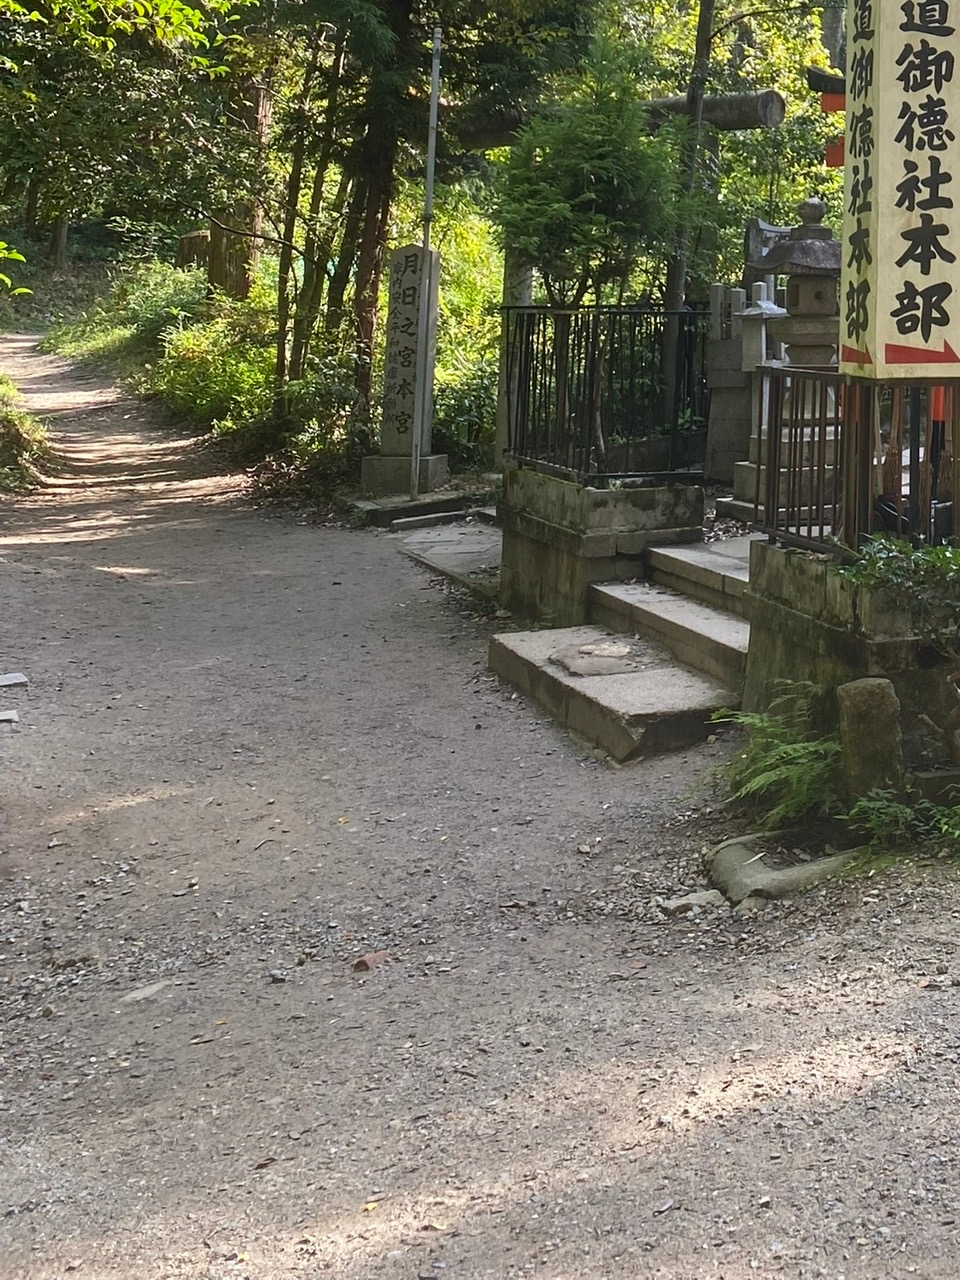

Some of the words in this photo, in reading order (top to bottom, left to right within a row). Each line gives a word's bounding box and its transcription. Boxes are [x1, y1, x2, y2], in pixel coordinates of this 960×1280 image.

[395, 252, 418, 435] 月日之宮本宮
